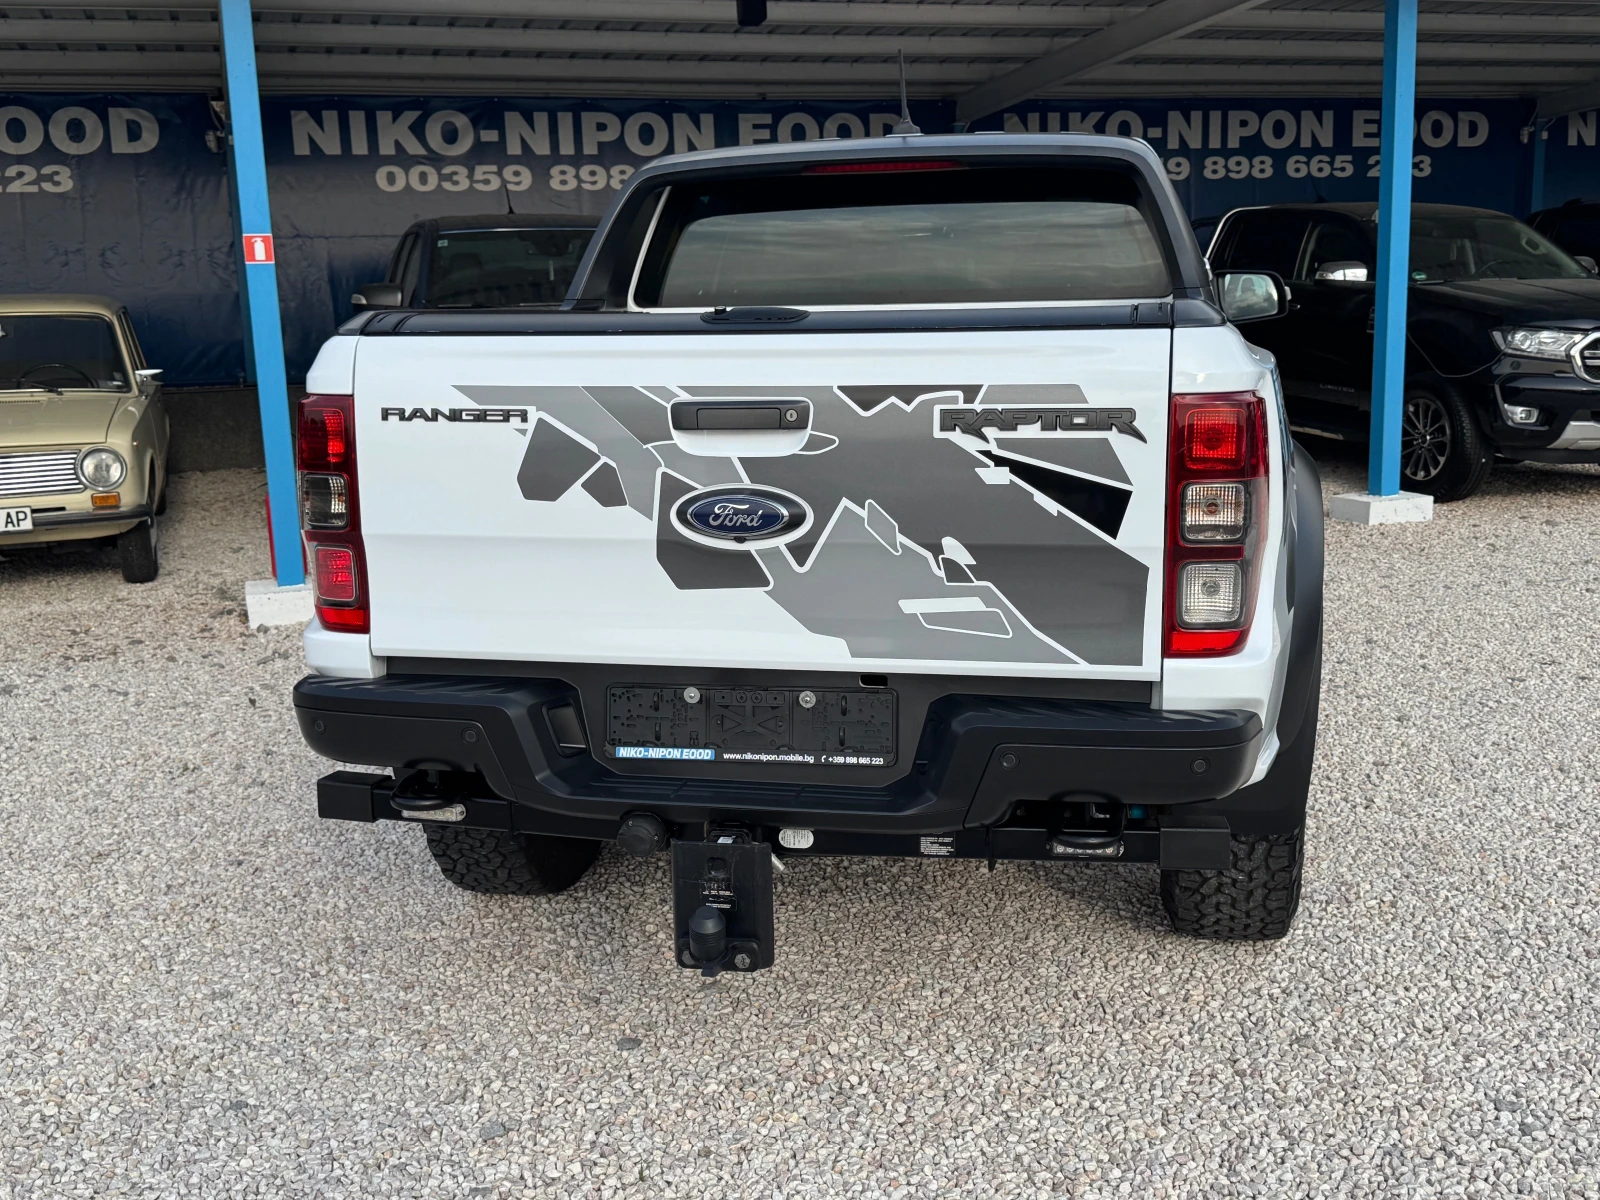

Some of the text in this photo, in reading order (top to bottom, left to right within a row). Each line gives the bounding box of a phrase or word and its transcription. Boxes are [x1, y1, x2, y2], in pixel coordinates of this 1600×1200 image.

[290, 110, 716, 156] NIKO-NIPON
[1352, 109, 1490, 148] EOD
[0, 164, 74, 193] 23
[375, 165, 636, 192] 00359 898
[1203, 156, 1274, 180] 898
[1285, 155, 1355, 178] 665
[1366, 154, 1432, 178] 23
[381, 407, 528, 423] RANGER
[939, 408, 1147, 443] RAPTOR
[4, 511, 28, 528] AP
[708, 503, 764, 528] Ford
[619, 747, 711, 759] NIKO-NIPON EOOD
[723, 753, 814, 763] www.nikonipon.mobile.bg
